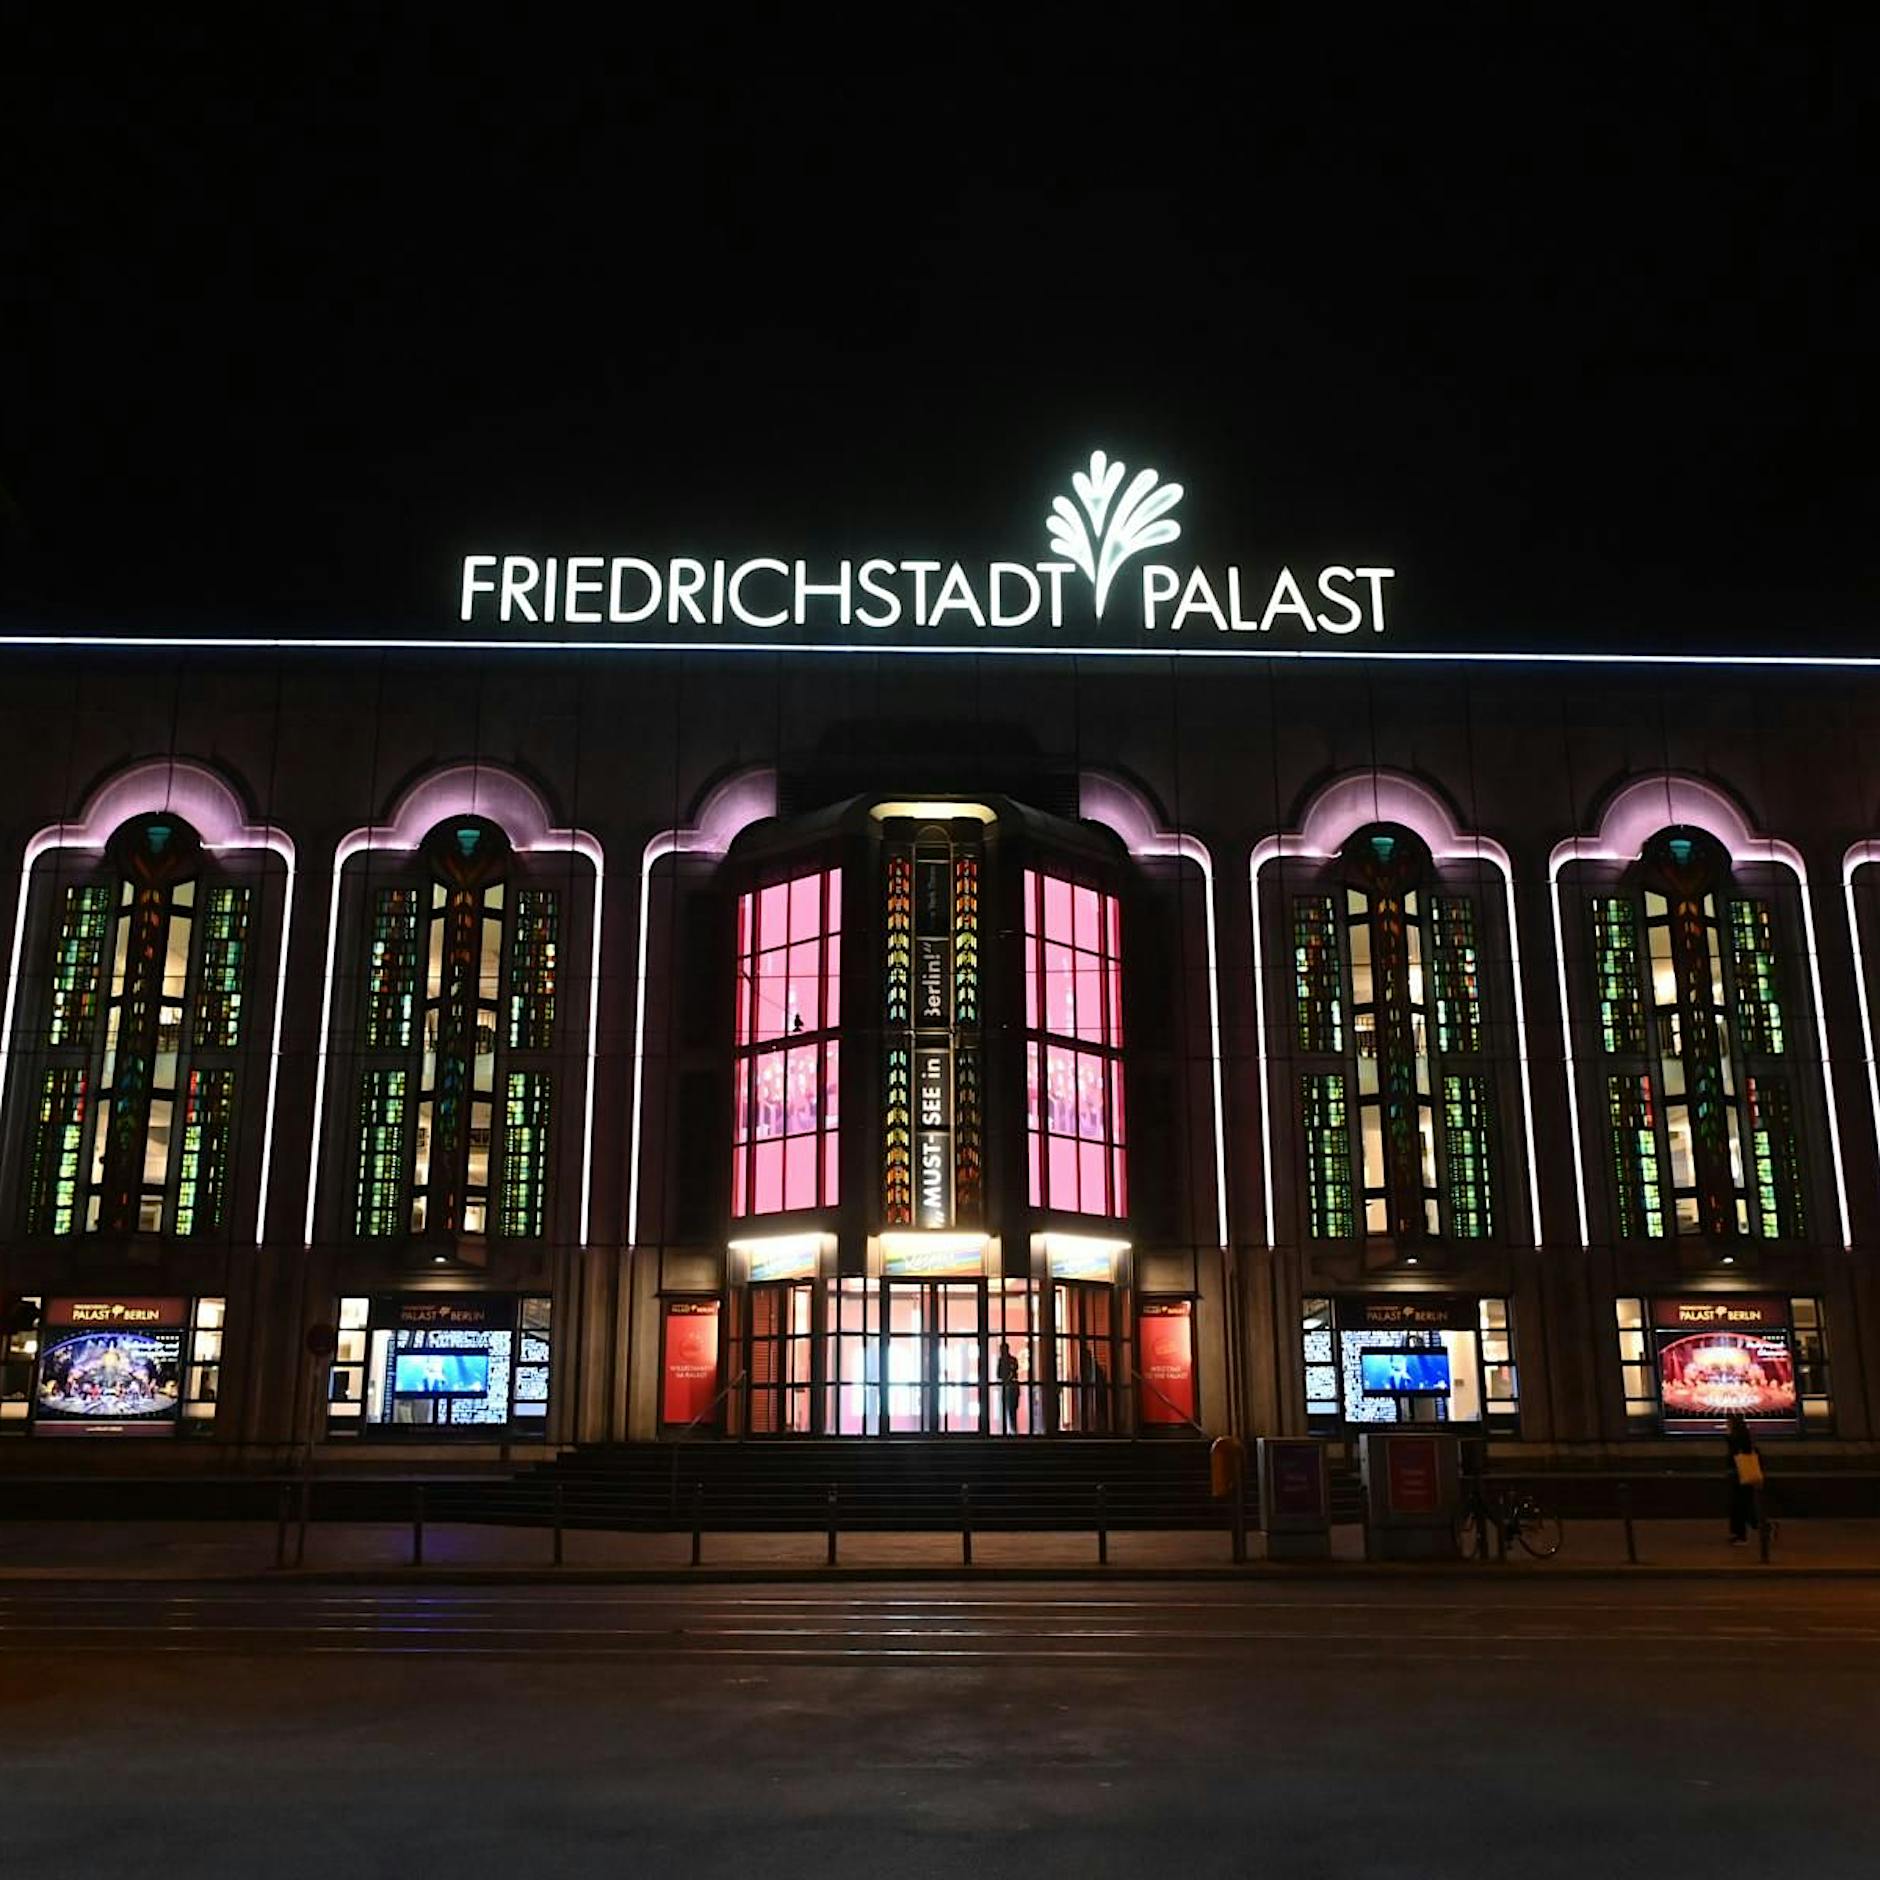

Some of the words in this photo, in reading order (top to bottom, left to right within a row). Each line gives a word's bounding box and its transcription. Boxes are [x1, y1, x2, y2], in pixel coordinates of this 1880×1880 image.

[461, 555, 1075, 627] FRIEDRICHSTADT
[1141, 563, 1395, 634] PALAST
[922, 1057, 942, 1079] in
[922, 1087, 942, 1126] SEE
[72, 1309, 110, 1320] PALAST
[123, 1309, 160, 1320] BERLIN
[402, 1311, 437, 1321] PALAST
[450, 1311, 485, 1321] BERLIN
[1366, 1311, 1401, 1321] PALAST
[1415, 1311, 1448, 1321] BERLIN
[1678, 1310, 1715, 1321] PALAST
[1727, 1310, 1761, 1321] BERLIN
